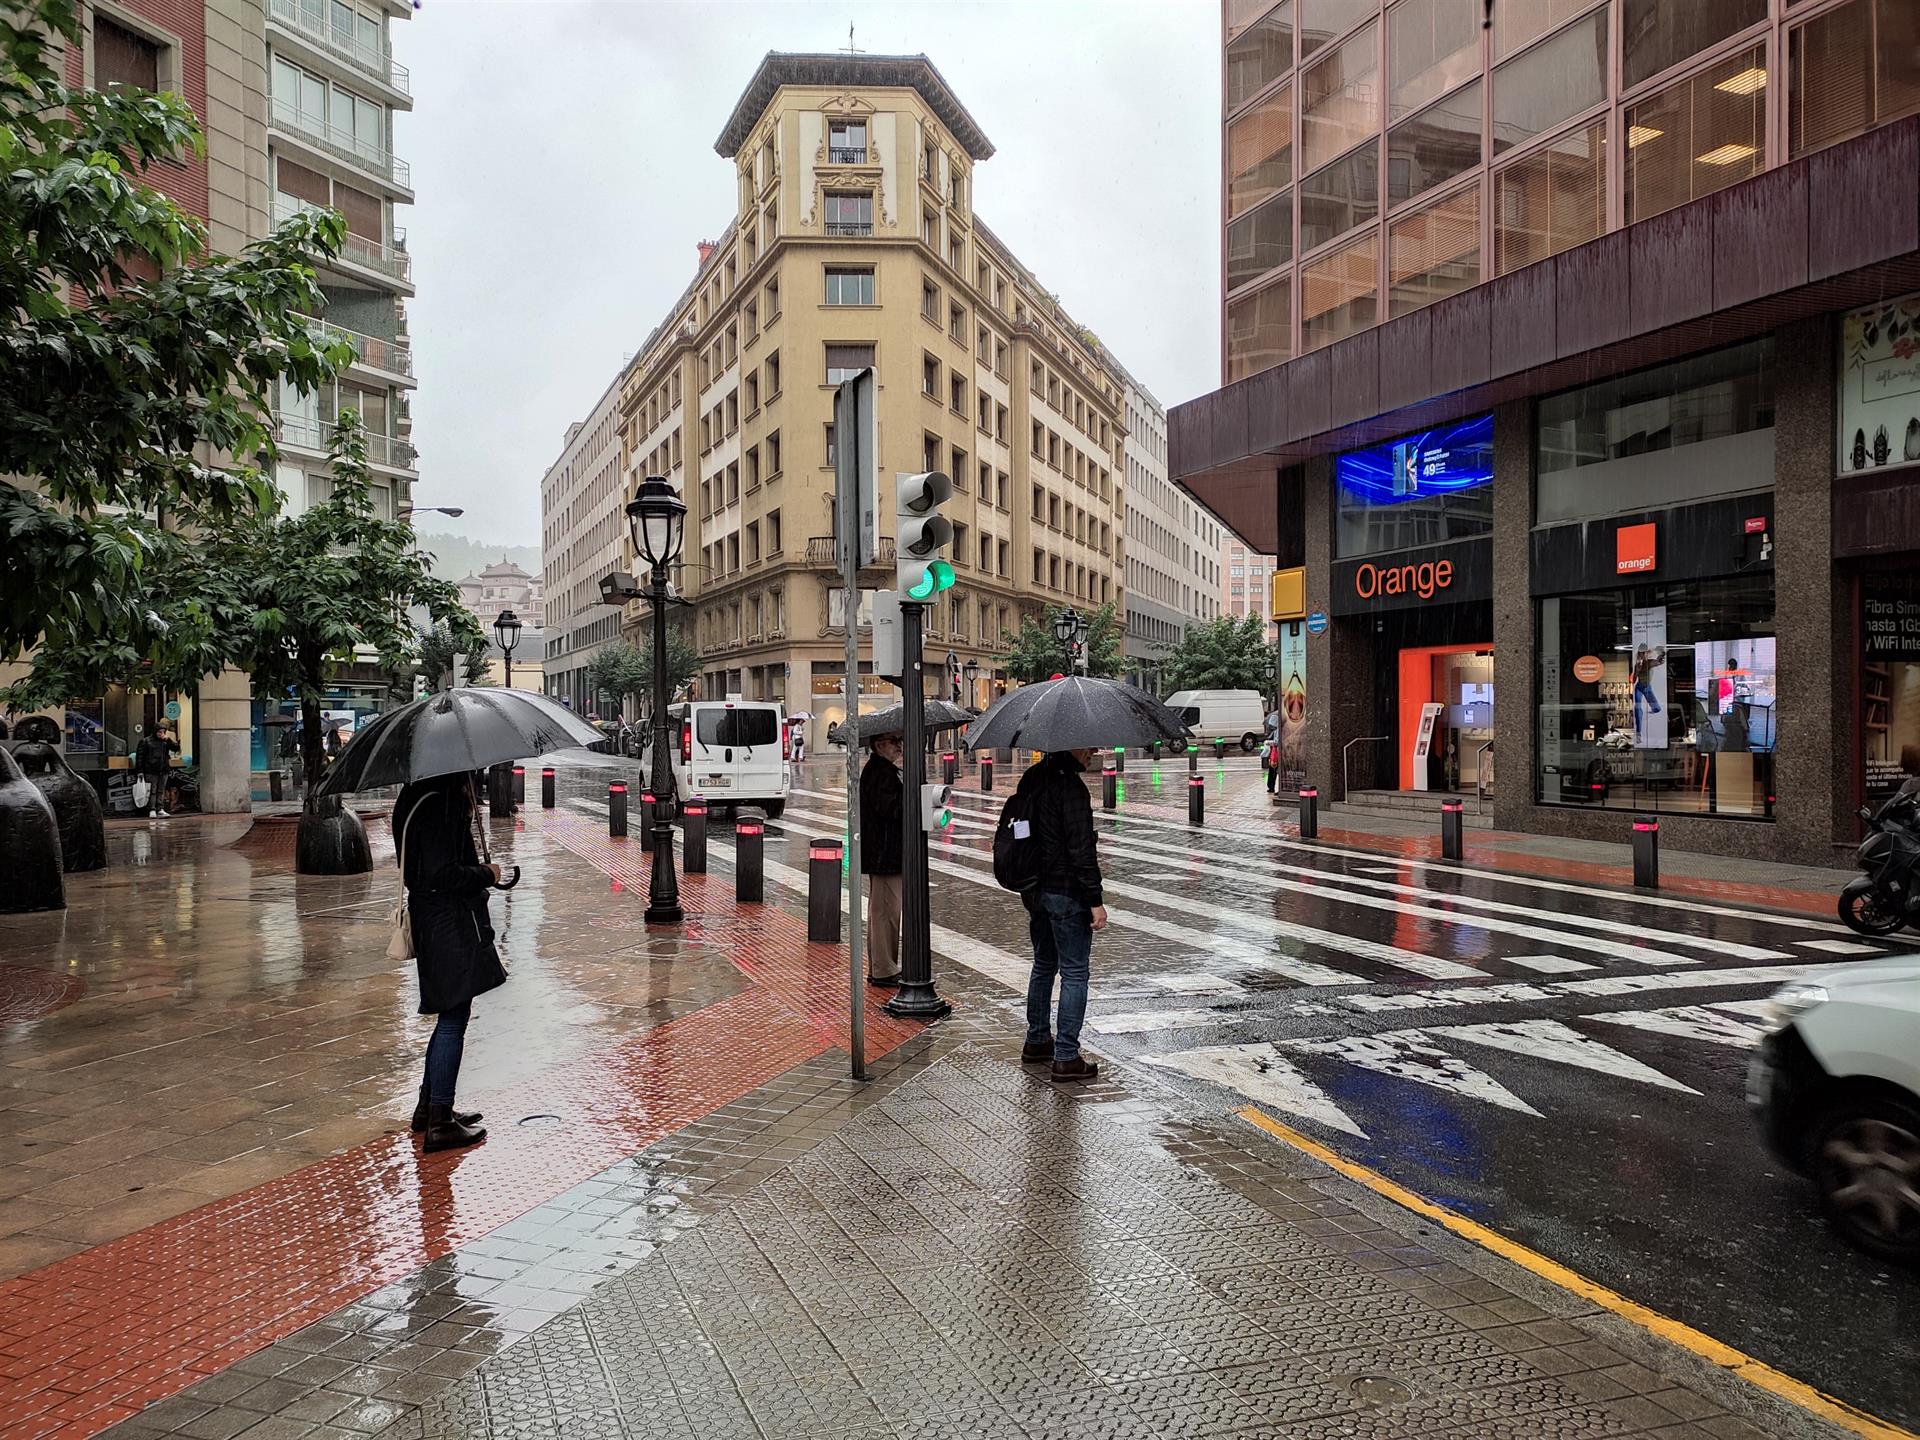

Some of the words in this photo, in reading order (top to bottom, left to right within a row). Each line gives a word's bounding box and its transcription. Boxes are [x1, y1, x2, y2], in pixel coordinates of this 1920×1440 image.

[1423, 463, 1435, 476] 49
[1618, 558, 1650, 569] orange
[1355, 559, 1453, 599] Orange
[1865, 599, 1893, 613] Fibra
[1873, 635, 1898, 649] WiFi
